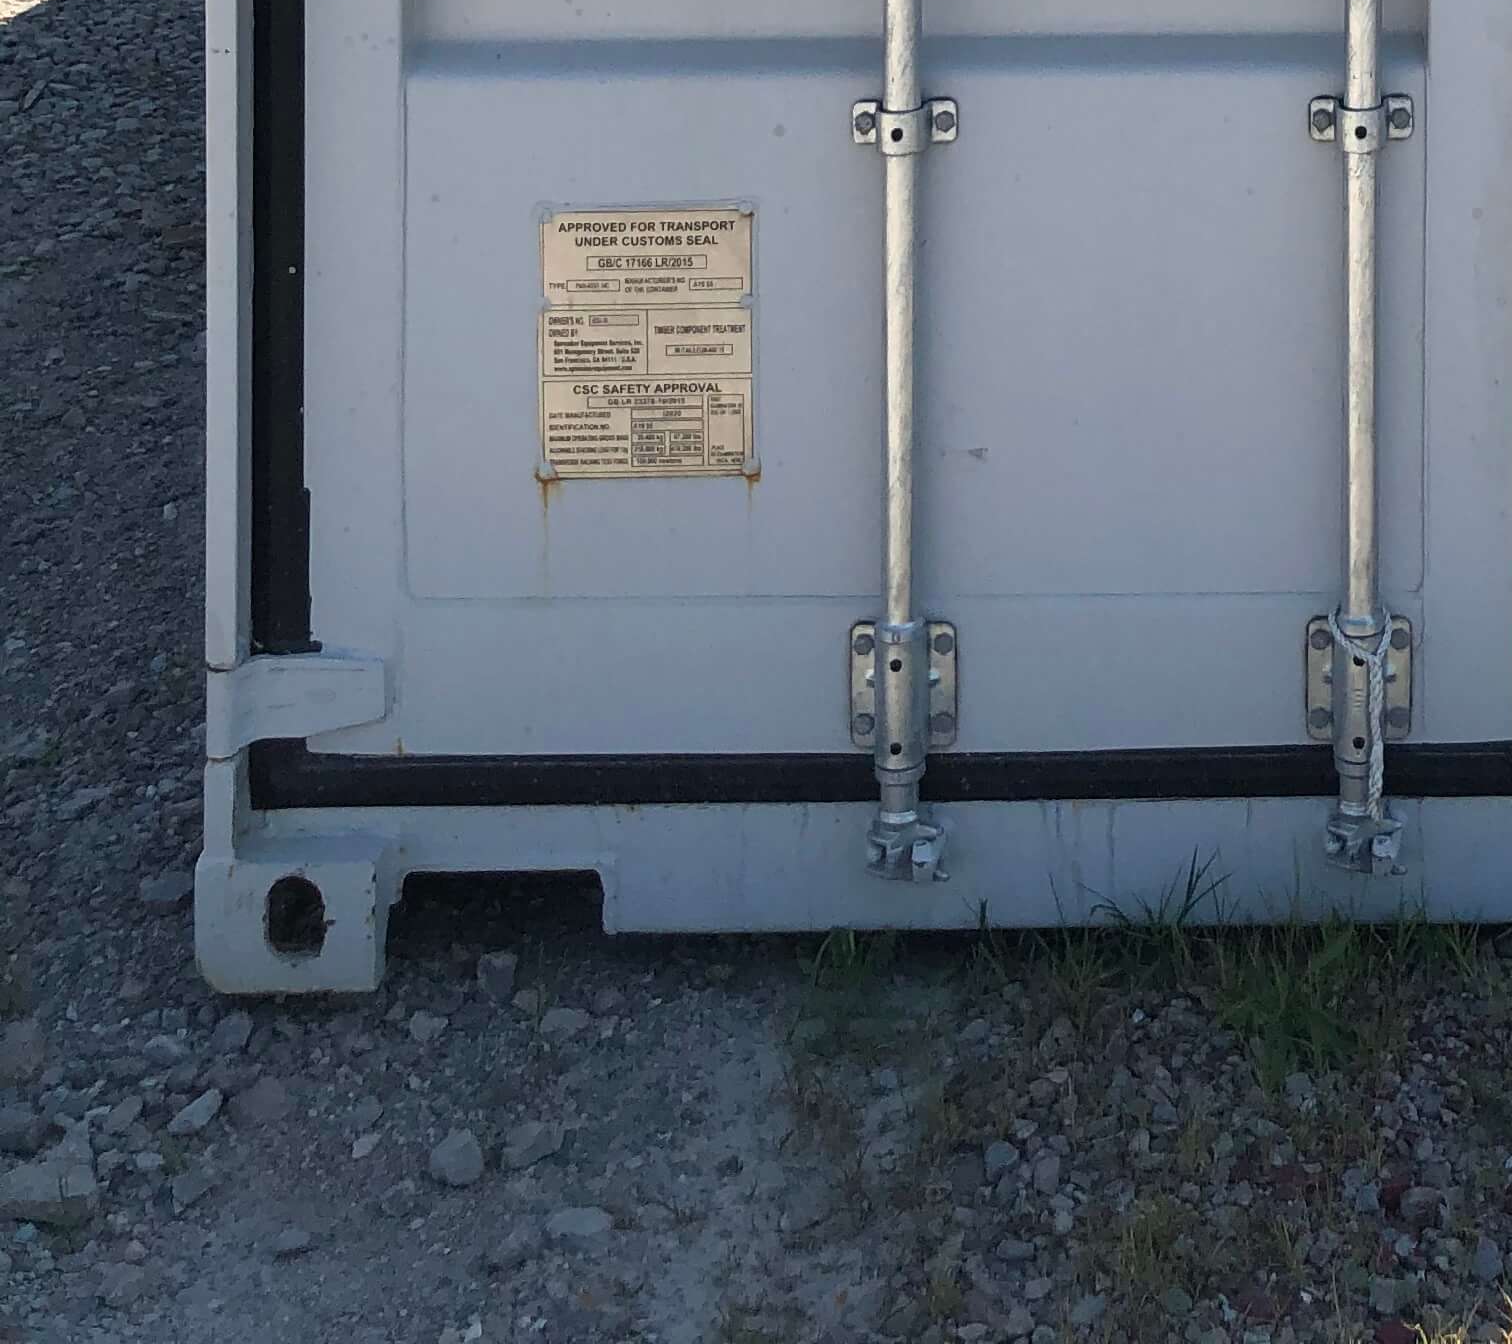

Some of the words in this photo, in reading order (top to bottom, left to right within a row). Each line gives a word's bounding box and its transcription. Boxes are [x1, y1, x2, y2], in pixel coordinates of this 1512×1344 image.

[558, 222, 626, 233] APPROVED
[630, 222, 656, 232] FOR
[659, 220, 736, 232] TRANSPORT
[575, 236, 618, 247] UNDER
[621, 235, 682, 246] CUSTOMS
[686, 235, 718, 245] SEAL
[573, 385, 599, 394] CSC
[602, 384, 650, 394] SAFETY
[655, 383, 722, 394] APPROVAL
